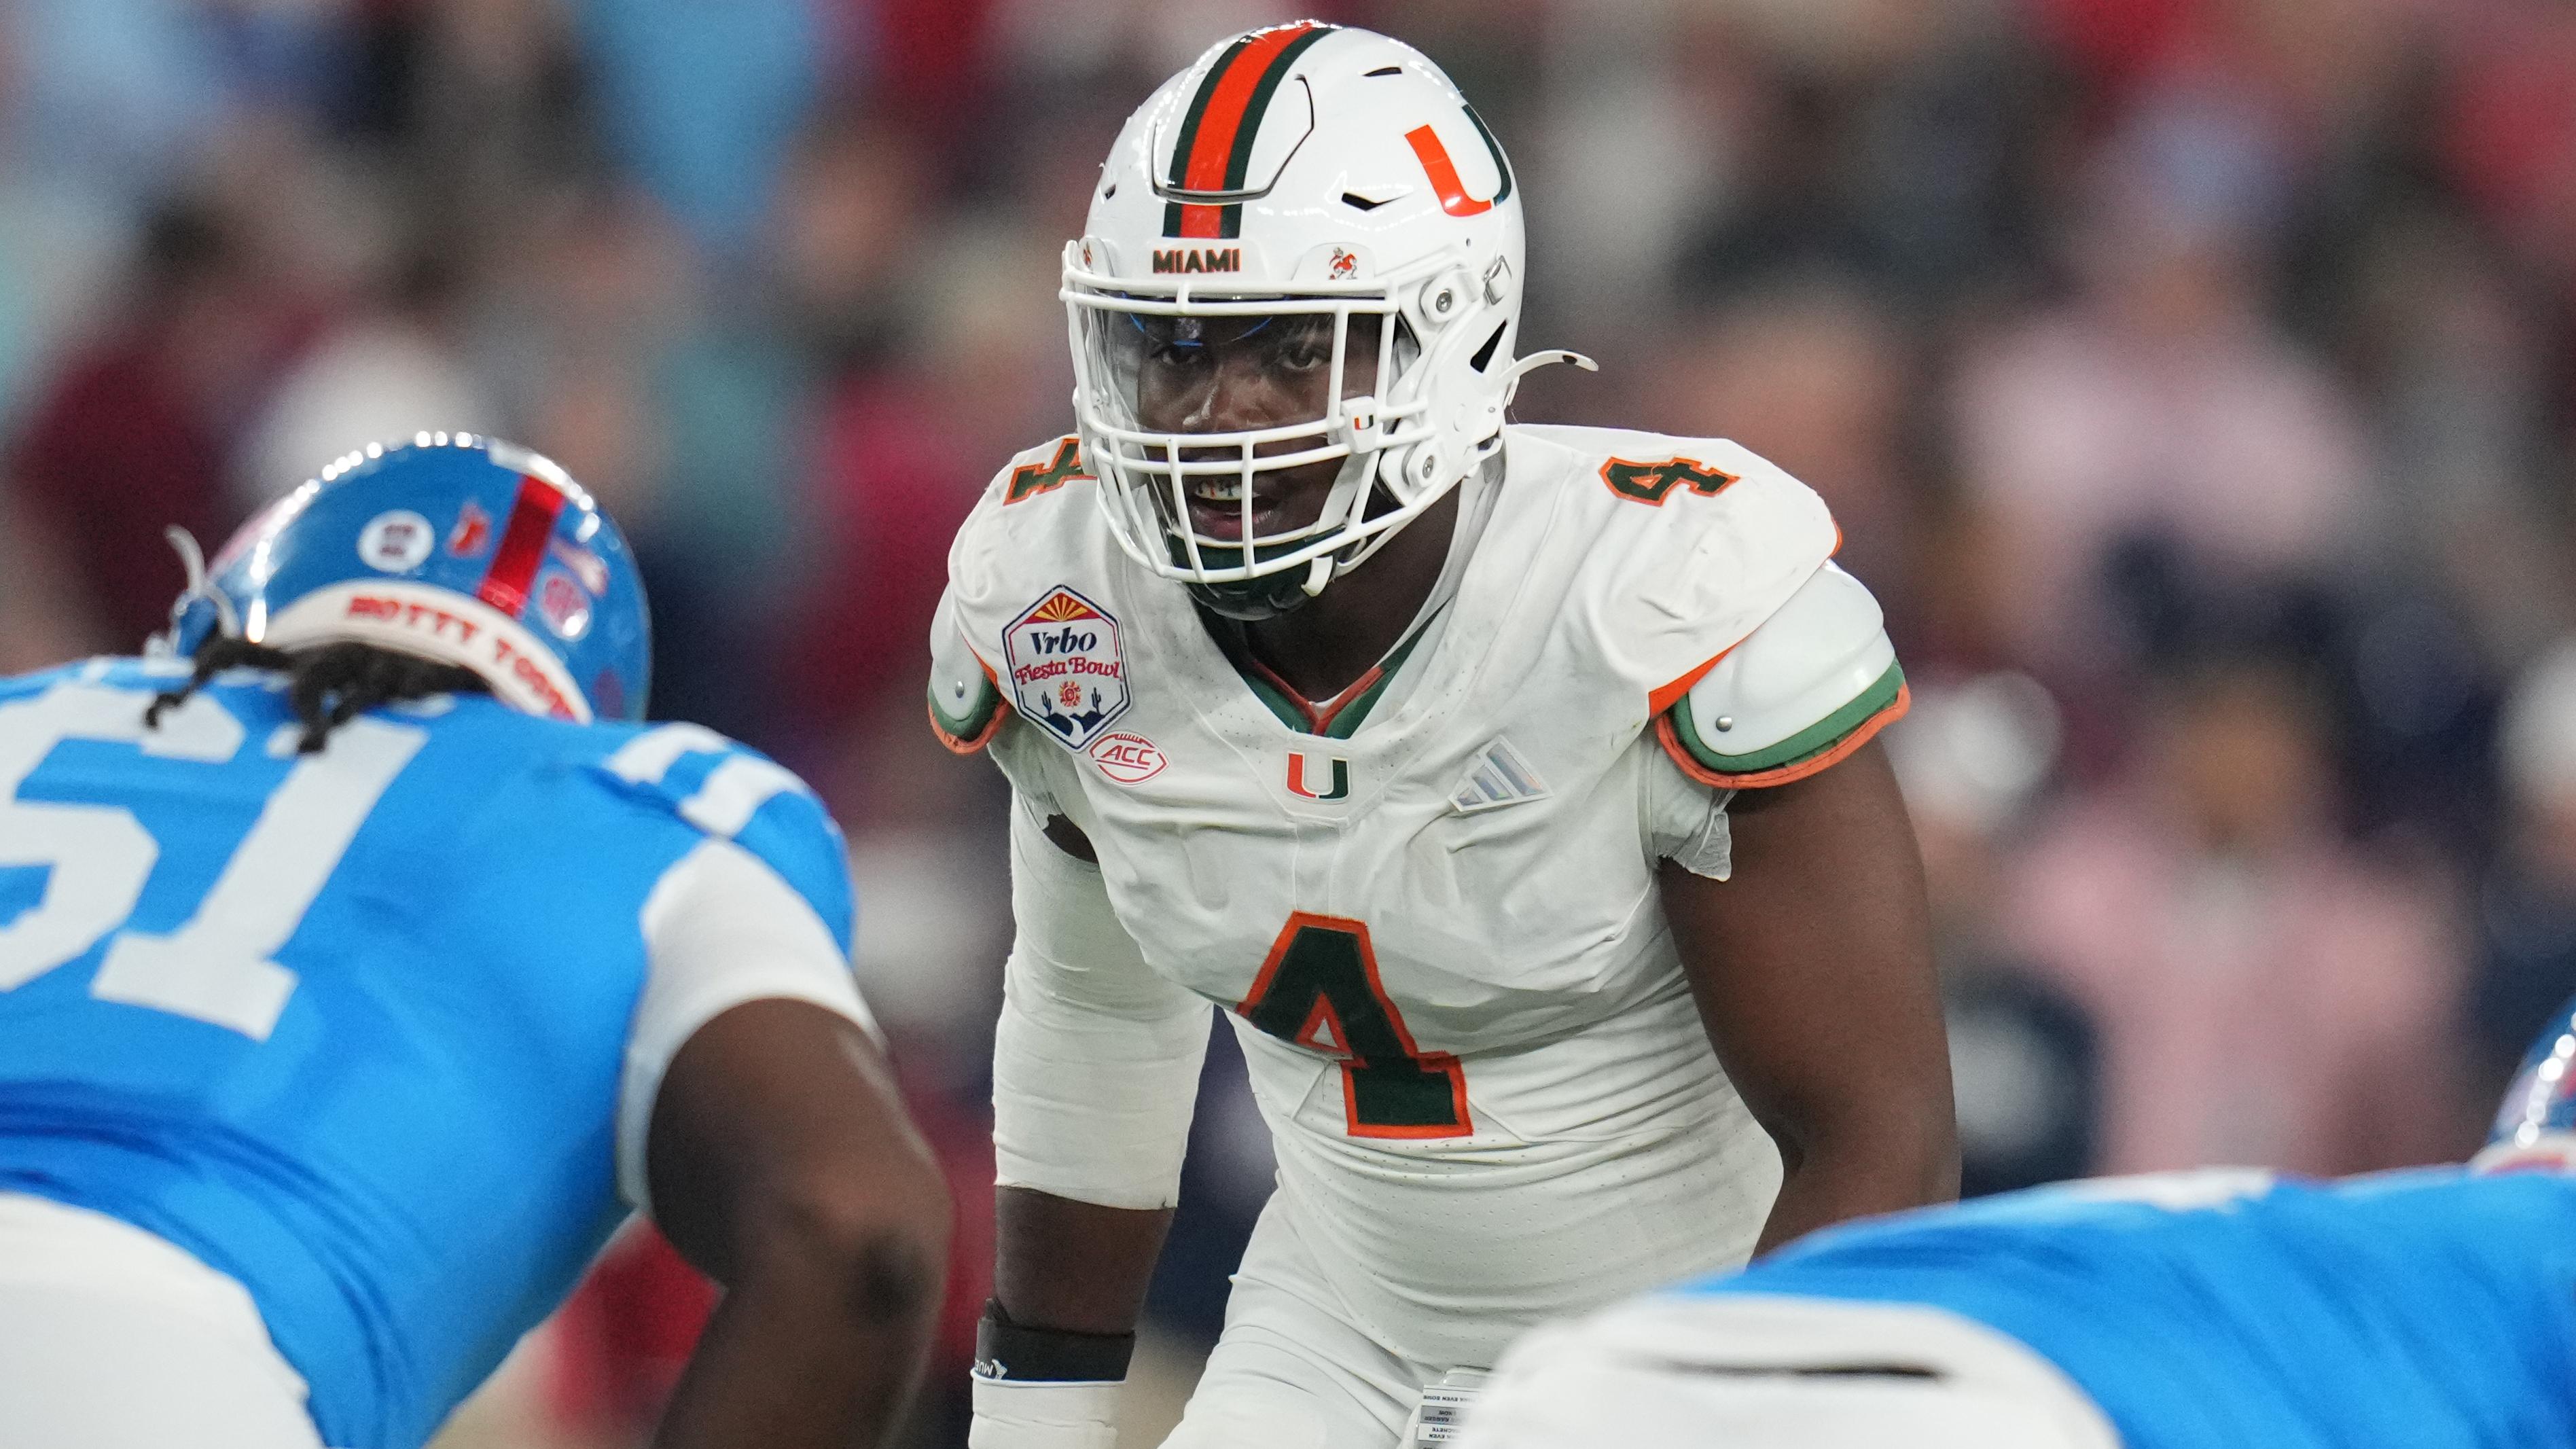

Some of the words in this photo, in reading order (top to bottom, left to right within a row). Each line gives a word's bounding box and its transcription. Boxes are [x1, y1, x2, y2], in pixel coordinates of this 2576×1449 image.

[1404, 103, 1511, 217] U
[1153, 249, 1240, 273] MIAMI
[1598, 457, 1740, 507] 4
[1030, 627, 1097, 654] Vrbo
[1014, 660, 1067, 685] Fiesta
[1069, 657, 1121, 679] Bowl
[1101, 745, 1156, 766] ACC
[1286, 751, 1350, 800] U
[1235, 910, 1473, 1139] 4
